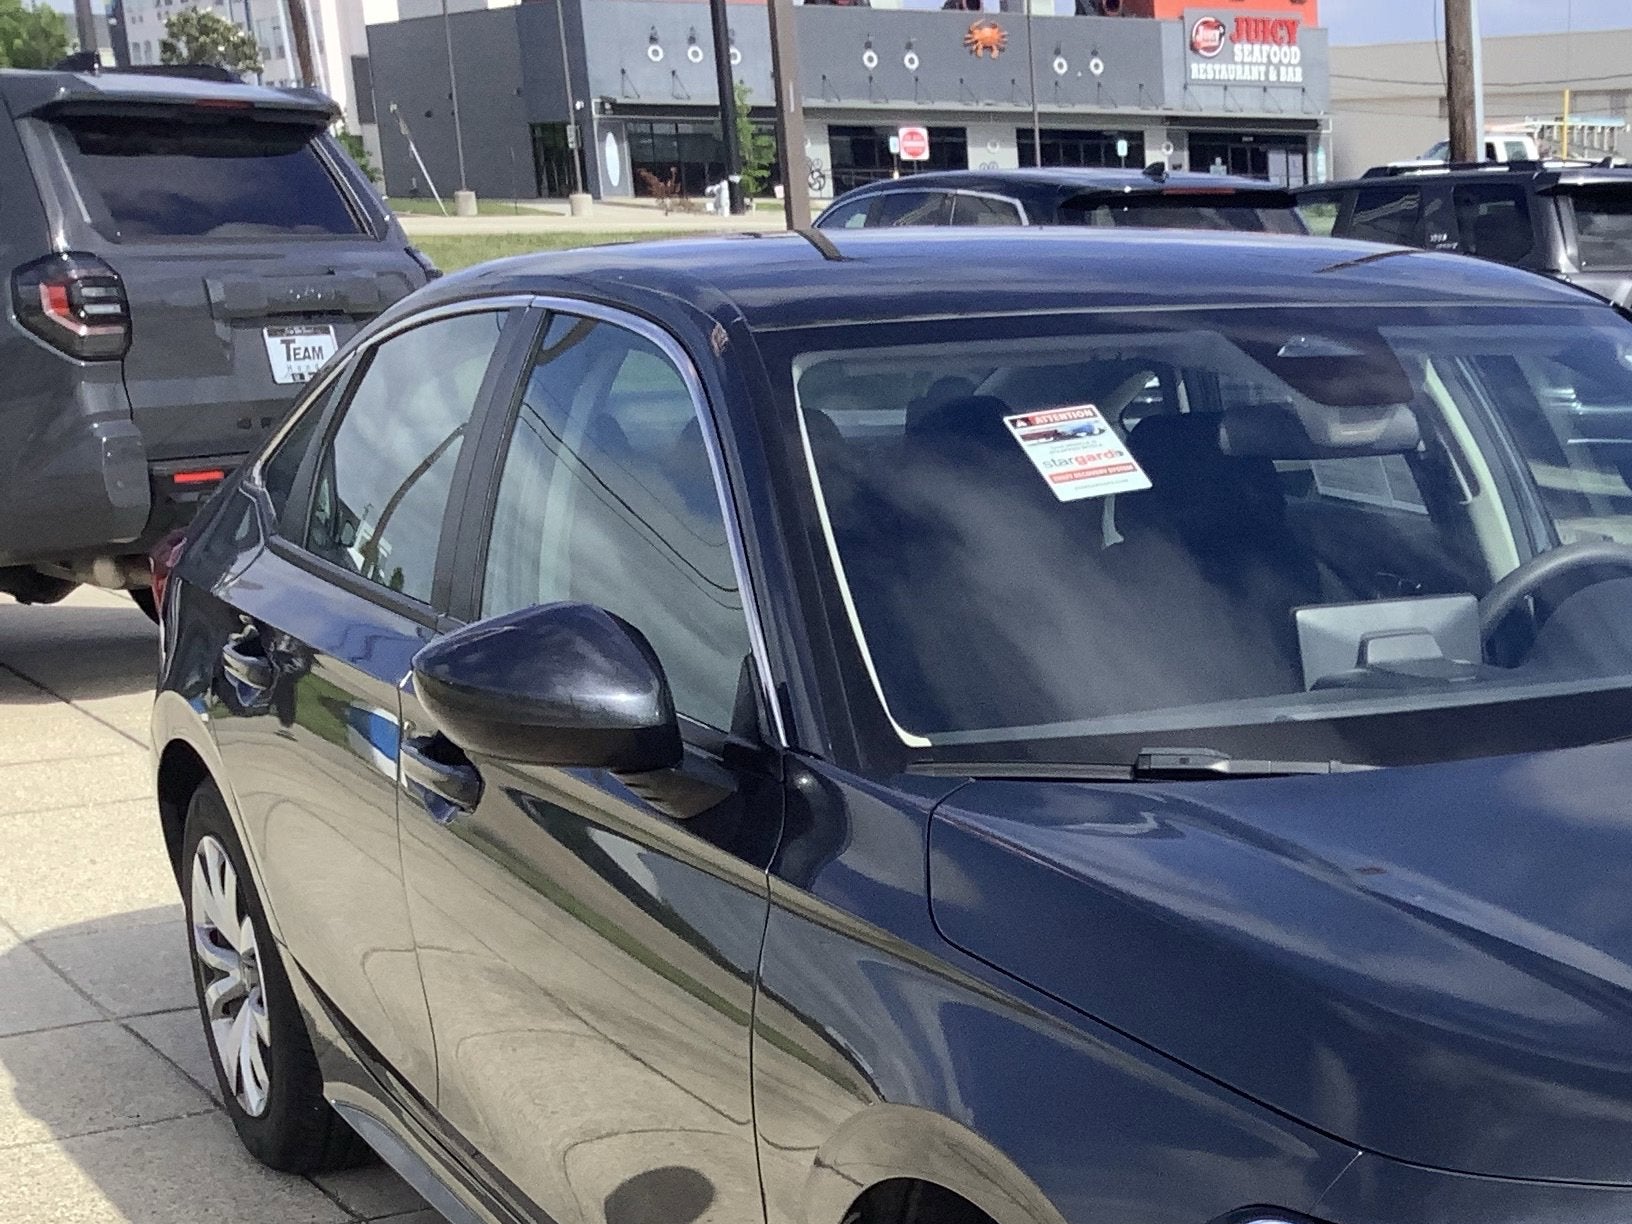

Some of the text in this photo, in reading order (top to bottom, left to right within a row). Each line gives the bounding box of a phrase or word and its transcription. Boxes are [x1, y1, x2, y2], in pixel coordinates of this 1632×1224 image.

[1229, 17, 1299, 45] JUICY
[1234, 43, 1301, 64] SEAFOOD
[1190, 63, 1302, 82] RESTAURANT & BAR
[280, 338, 324, 361] TEAM
[1034, 408, 1094, 425] ATTENTION
